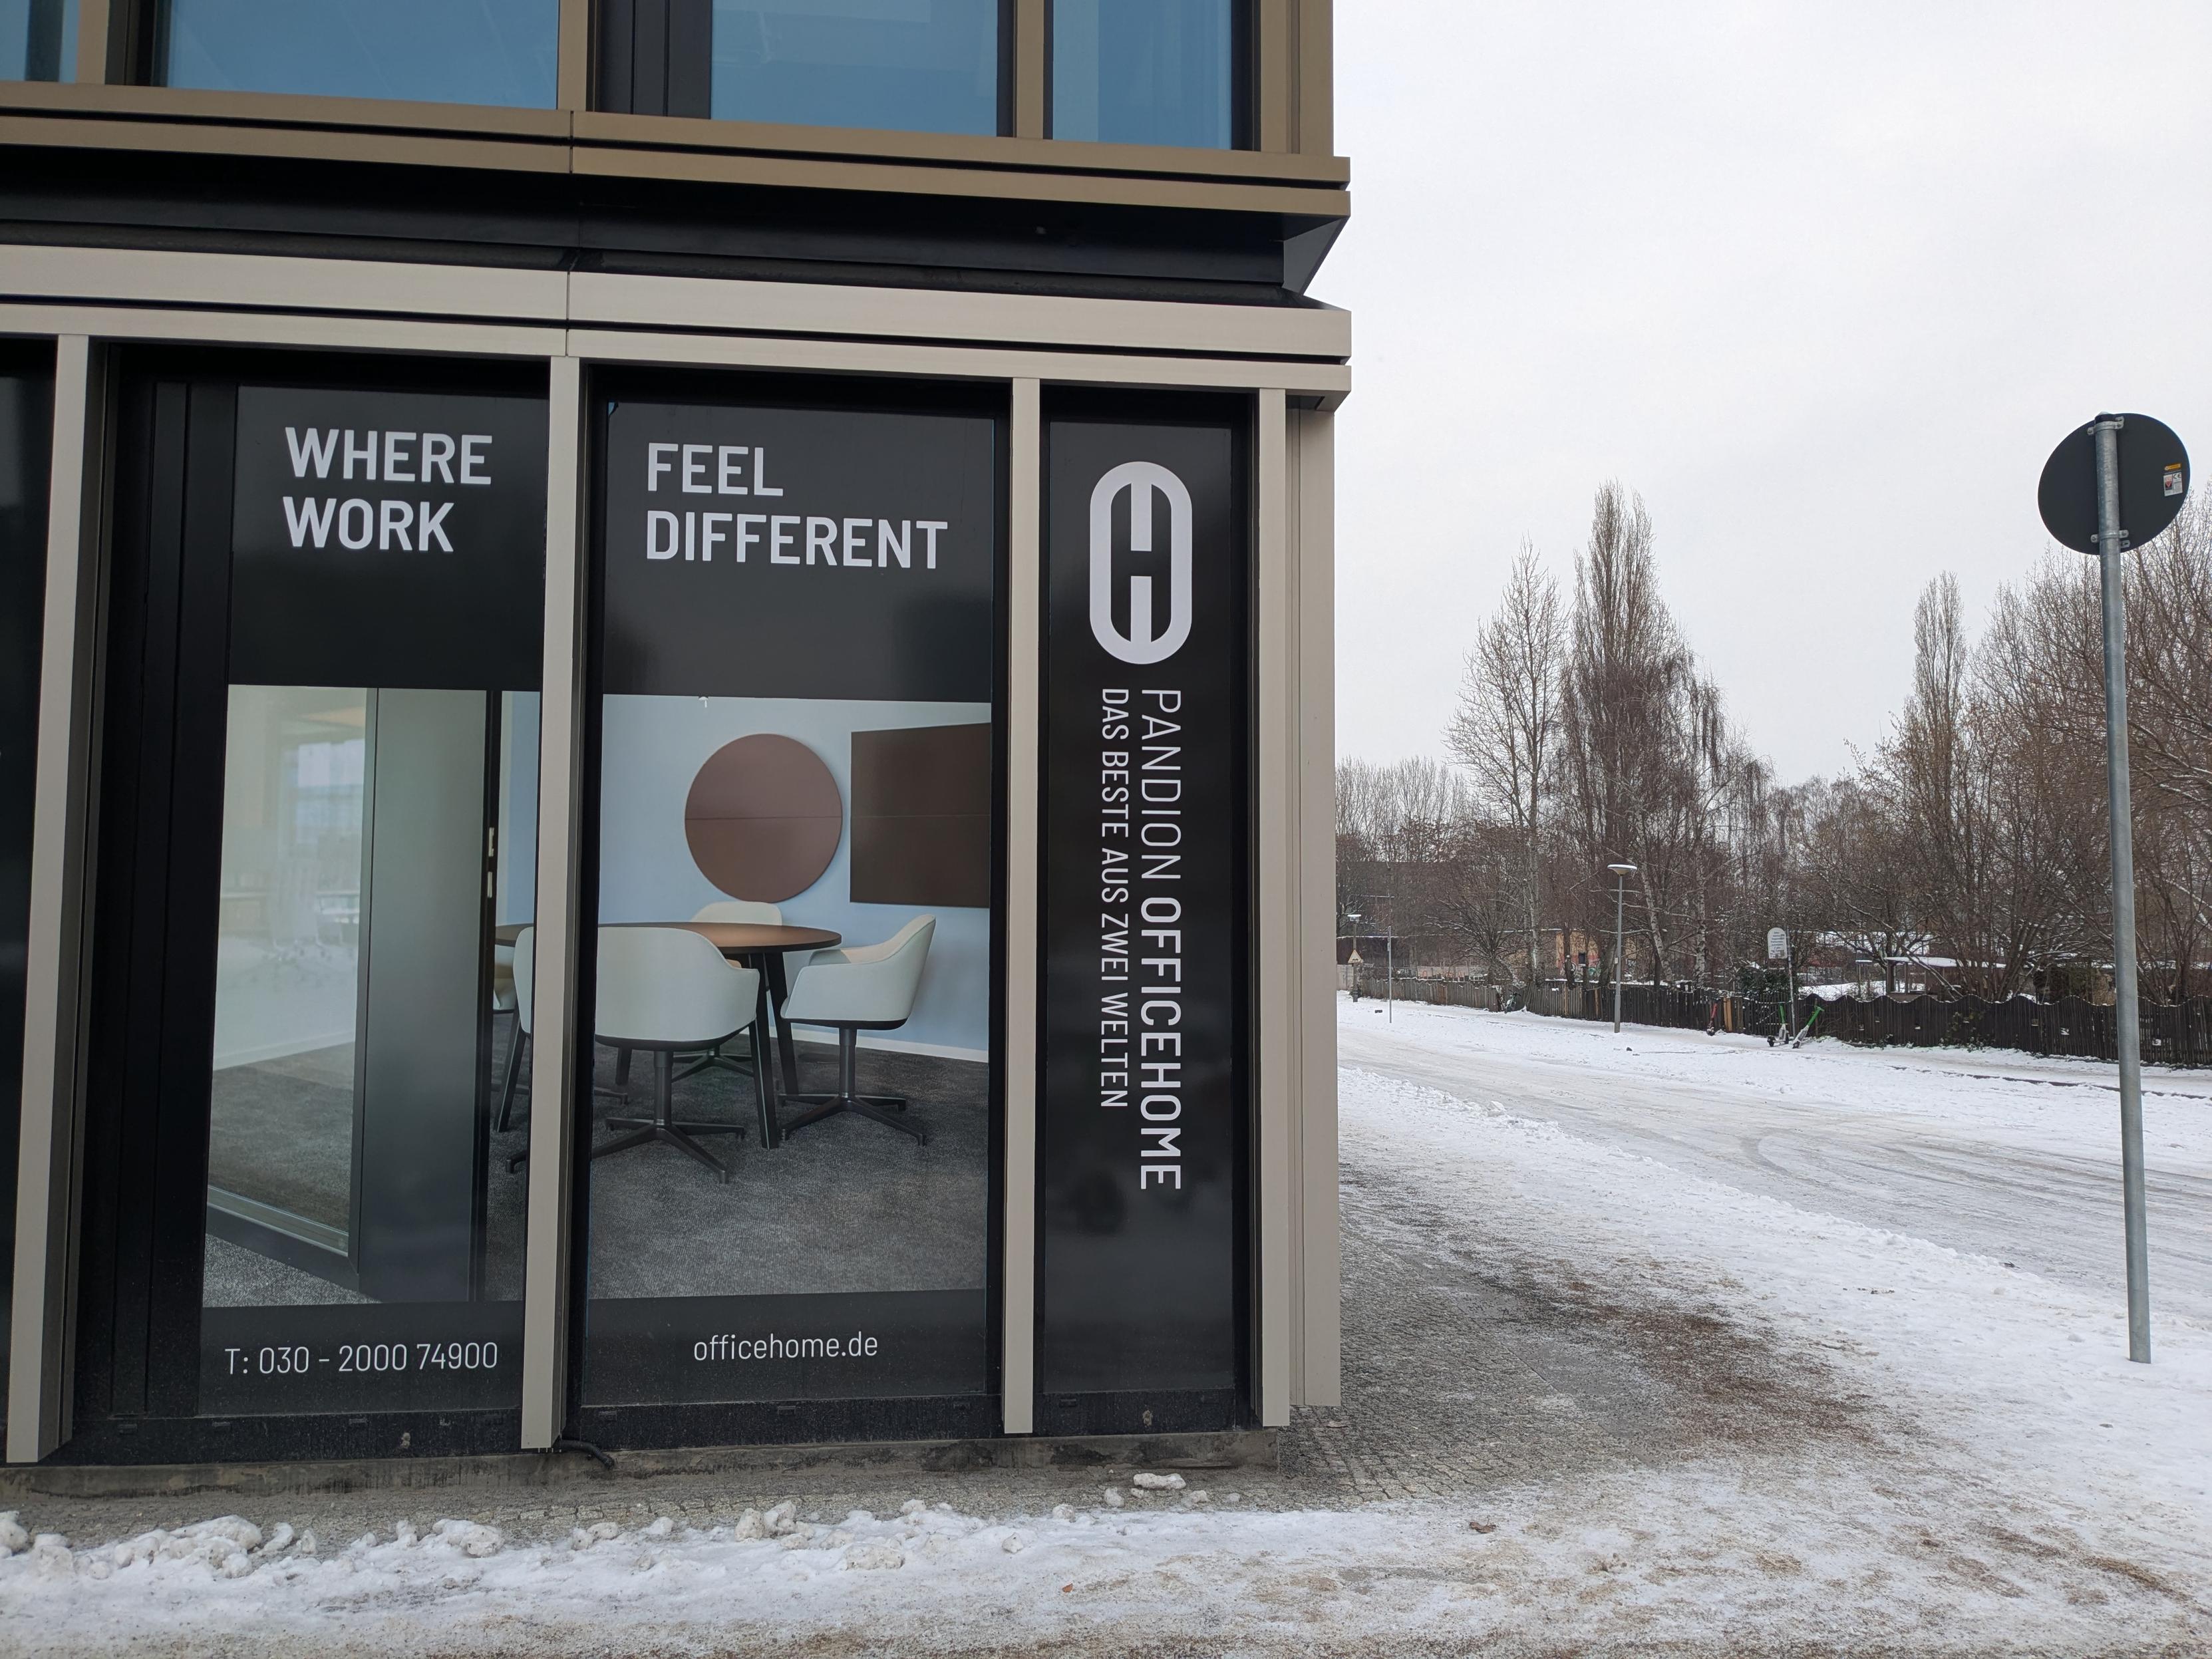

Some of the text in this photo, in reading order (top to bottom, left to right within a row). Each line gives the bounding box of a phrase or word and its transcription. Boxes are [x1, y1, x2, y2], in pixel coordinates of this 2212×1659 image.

[285, 426, 492, 485] WHERE
[647, 442, 784, 497] FEEL
[282, 496, 454, 552] WORK
[647, 510, 948, 569] DIFFERENT
[1100, 688, 1129, 1108] DAS BESTE AUS ZWEI WELTEN
[1140, 688, 1182, 1189] PANDION OFFICEHOME
[225, 1348, 249, 1374] T:
[259, 1346, 309, 1374] 030
[339, 1344, 407, 1372] 2000
[416, 1342, 498, 1370] 74900
[694, 1330, 878, 1361] officehome.de
